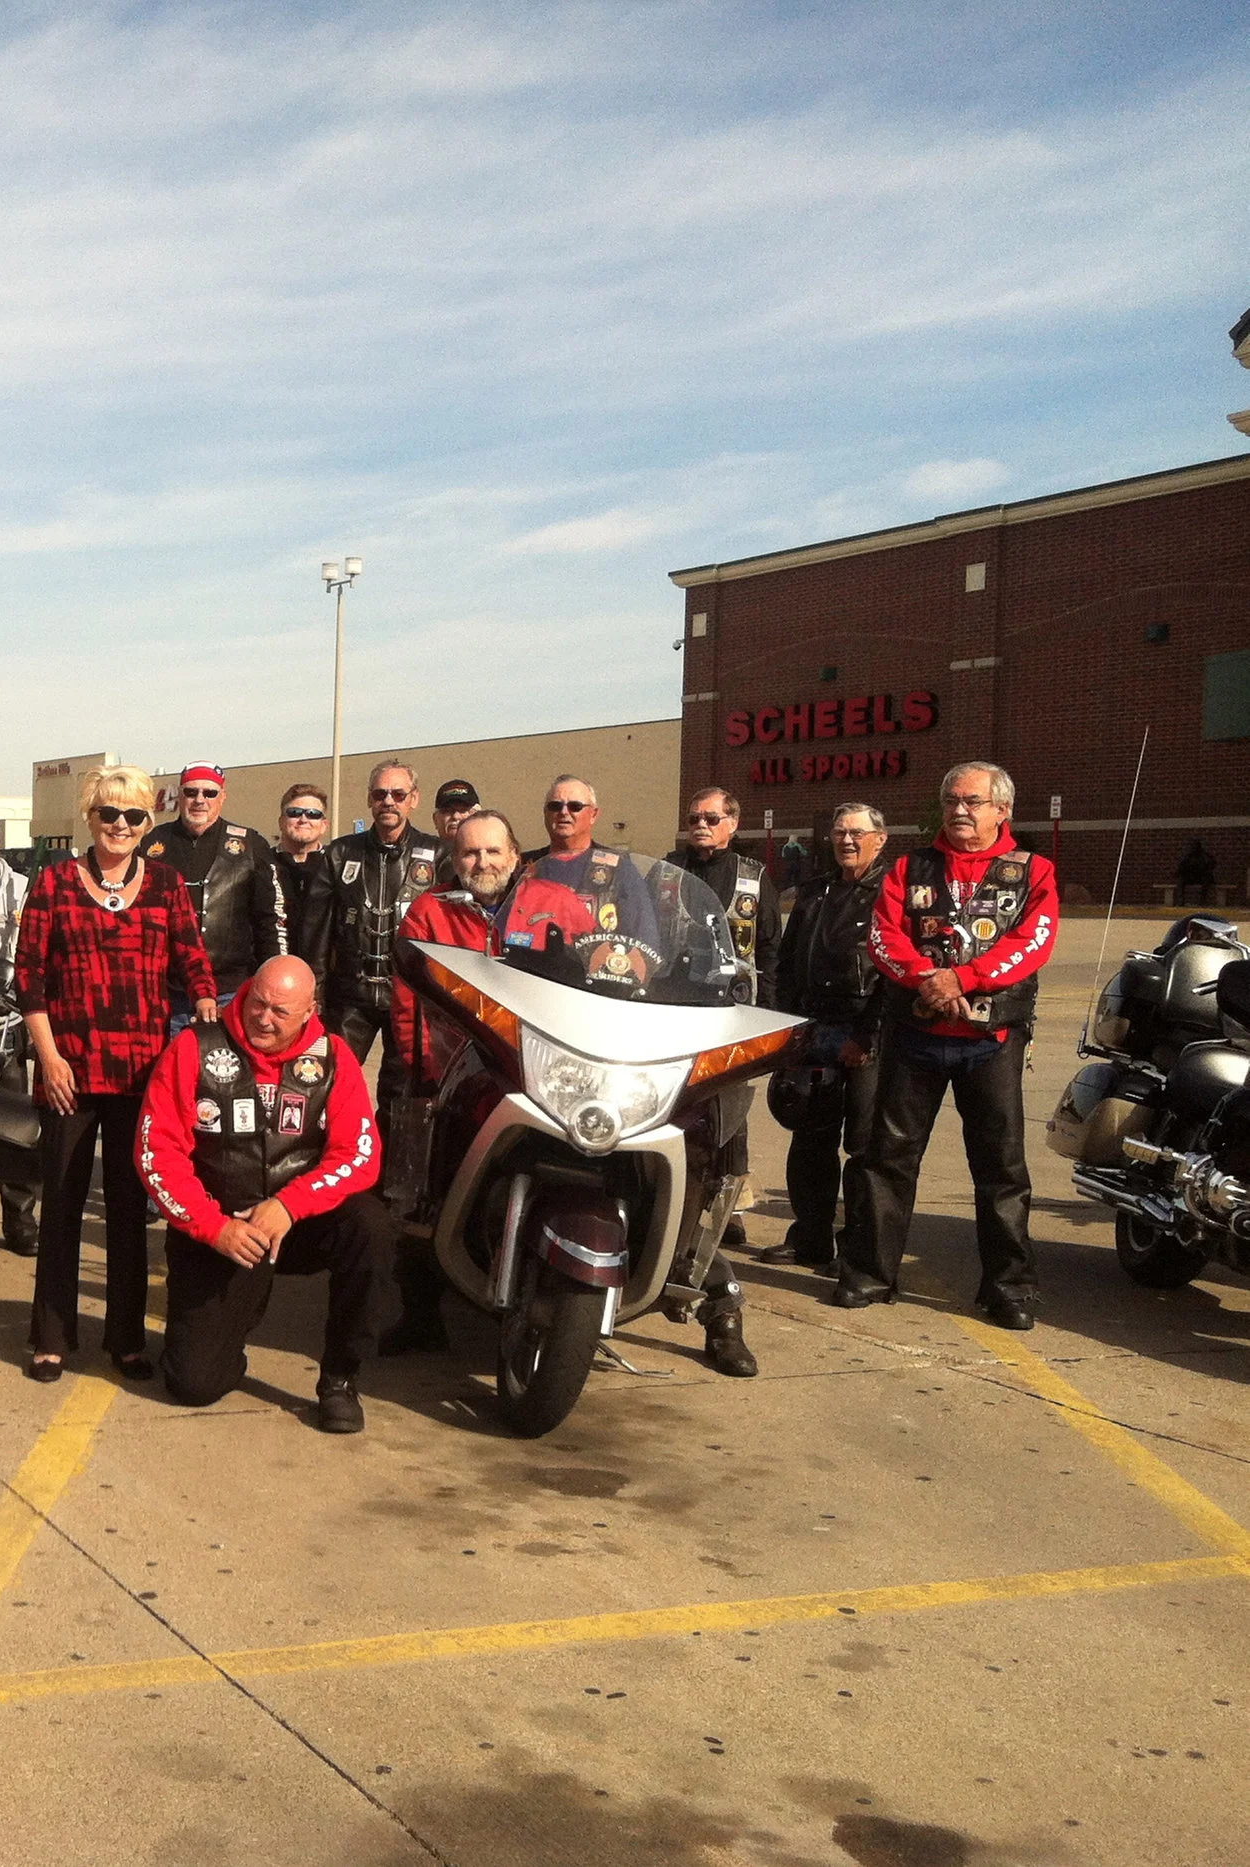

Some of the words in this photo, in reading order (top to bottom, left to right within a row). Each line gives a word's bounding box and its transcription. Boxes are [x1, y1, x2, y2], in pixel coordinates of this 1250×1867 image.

[724, 690, 934, 747] SCHEELS
[750, 758, 790, 785] ALL
[800, 750, 903, 782] SPORTS
[575, 933, 627, 950] AMERICAN
[628, 938, 663, 965] LEGION
[1024, 914, 1051, 954] POST
